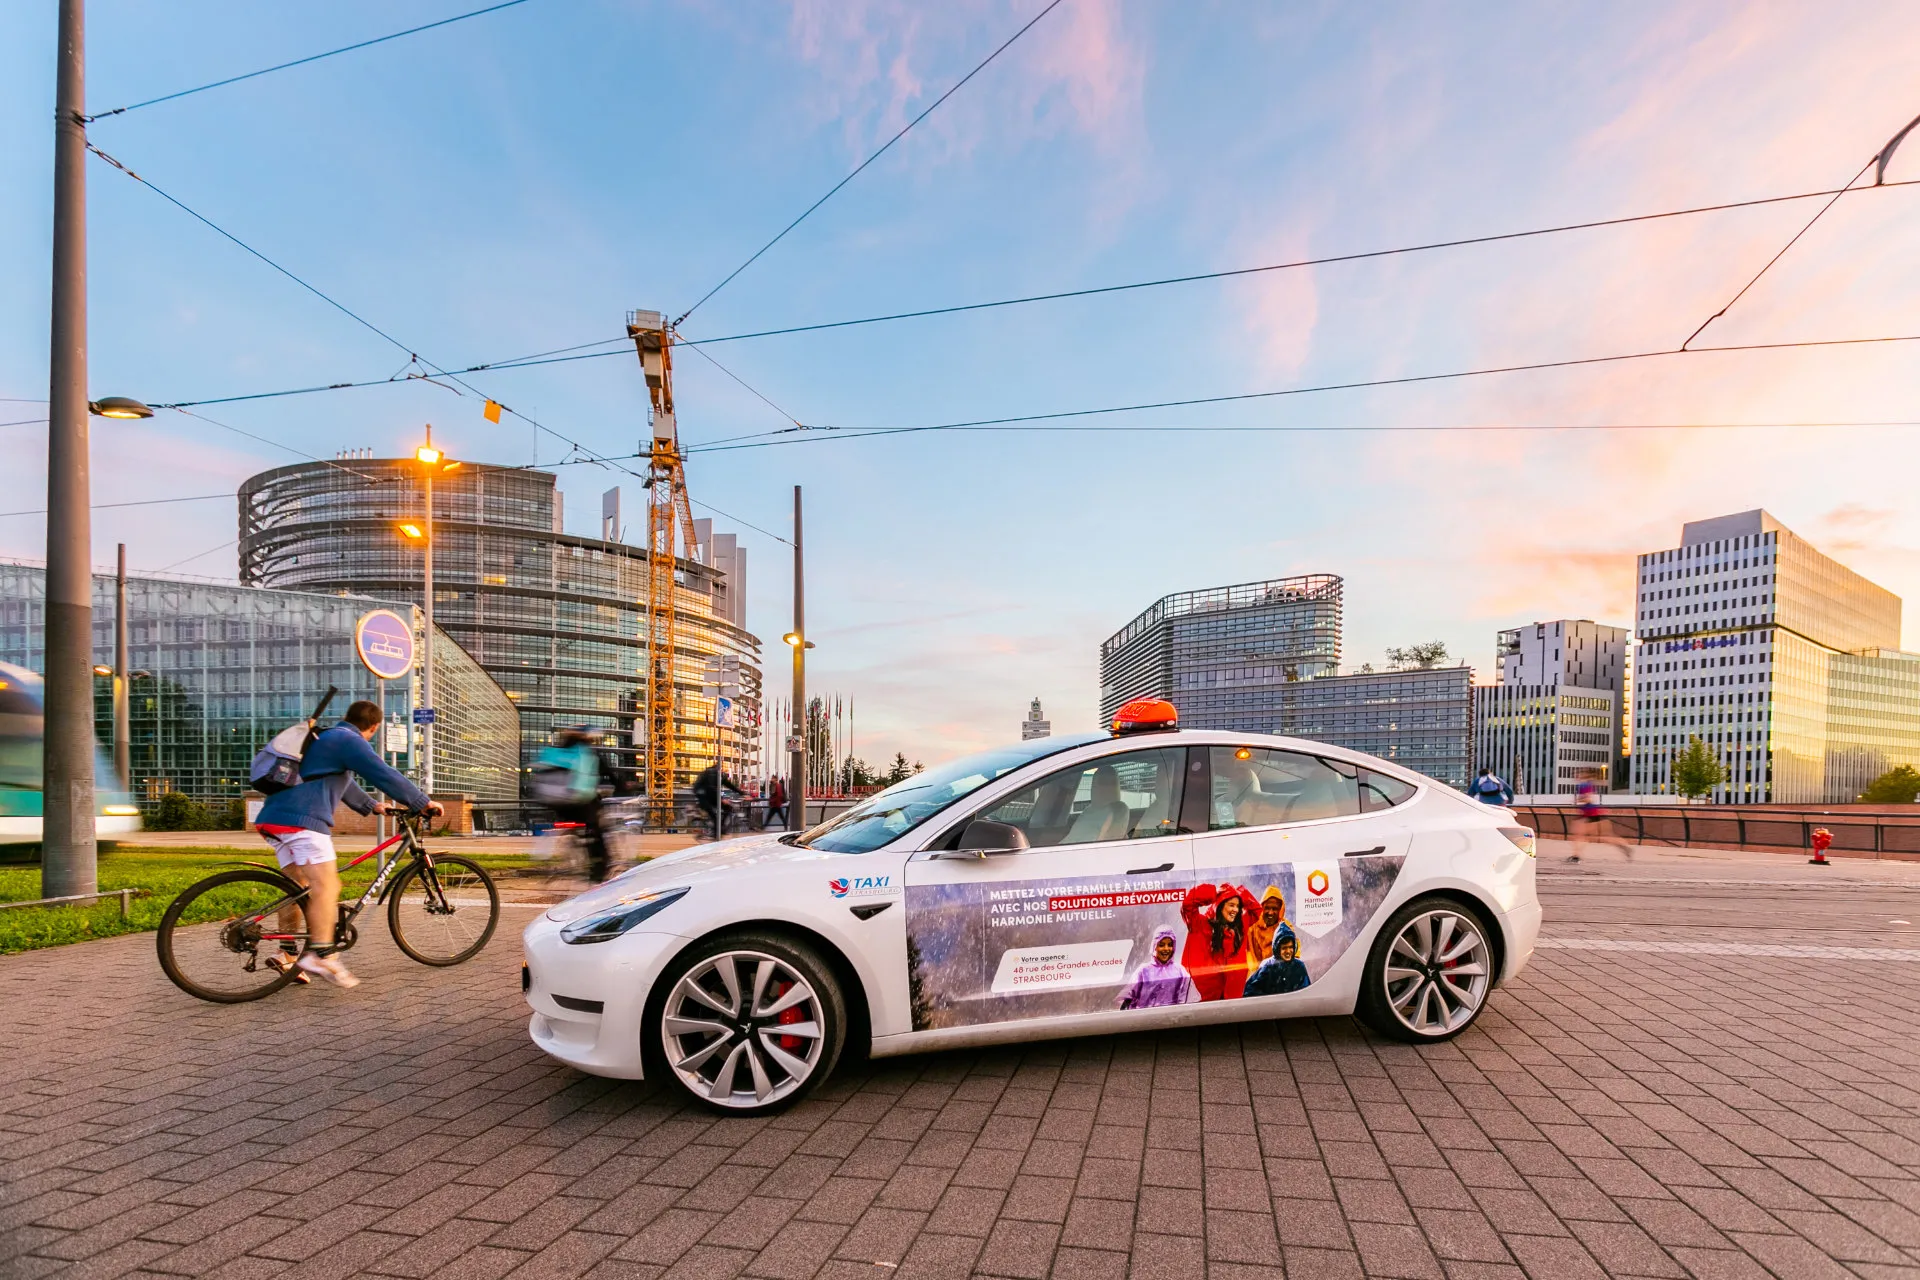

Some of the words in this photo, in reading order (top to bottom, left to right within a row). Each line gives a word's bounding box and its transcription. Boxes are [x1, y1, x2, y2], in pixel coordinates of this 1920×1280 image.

[854, 876, 890, 888] TAXI
[990, 888, 1035, 900] METTEZ
[1037, 886, 1074, 897] VOTRE
[1076, 883, 1121, 895] FAMILLE
[1124, 880, 1131, 891] À
[1134, 880, 1164, 891] L'ABRI
[991, 903, 1020, 913] AVEC
[1023, 901, 1047, 912] NOS
[1051, 897, 1113, 909] SOLUTIONS
[1116, 891, 1185, 905] PRÉVOYANCE
[991, 914, 1053, 927] HARMONIE
[1055, 910, 1116, 923] MUTUELLE.
[1013, 966, 1024, 974] 48
[1041, 964, 1055, 972] des
[1056, 960, 1090, 970] Grandes
[1091, 957, 1123, 967] Arcades
[1013, 972, 1072, 984] STRASBOURG
